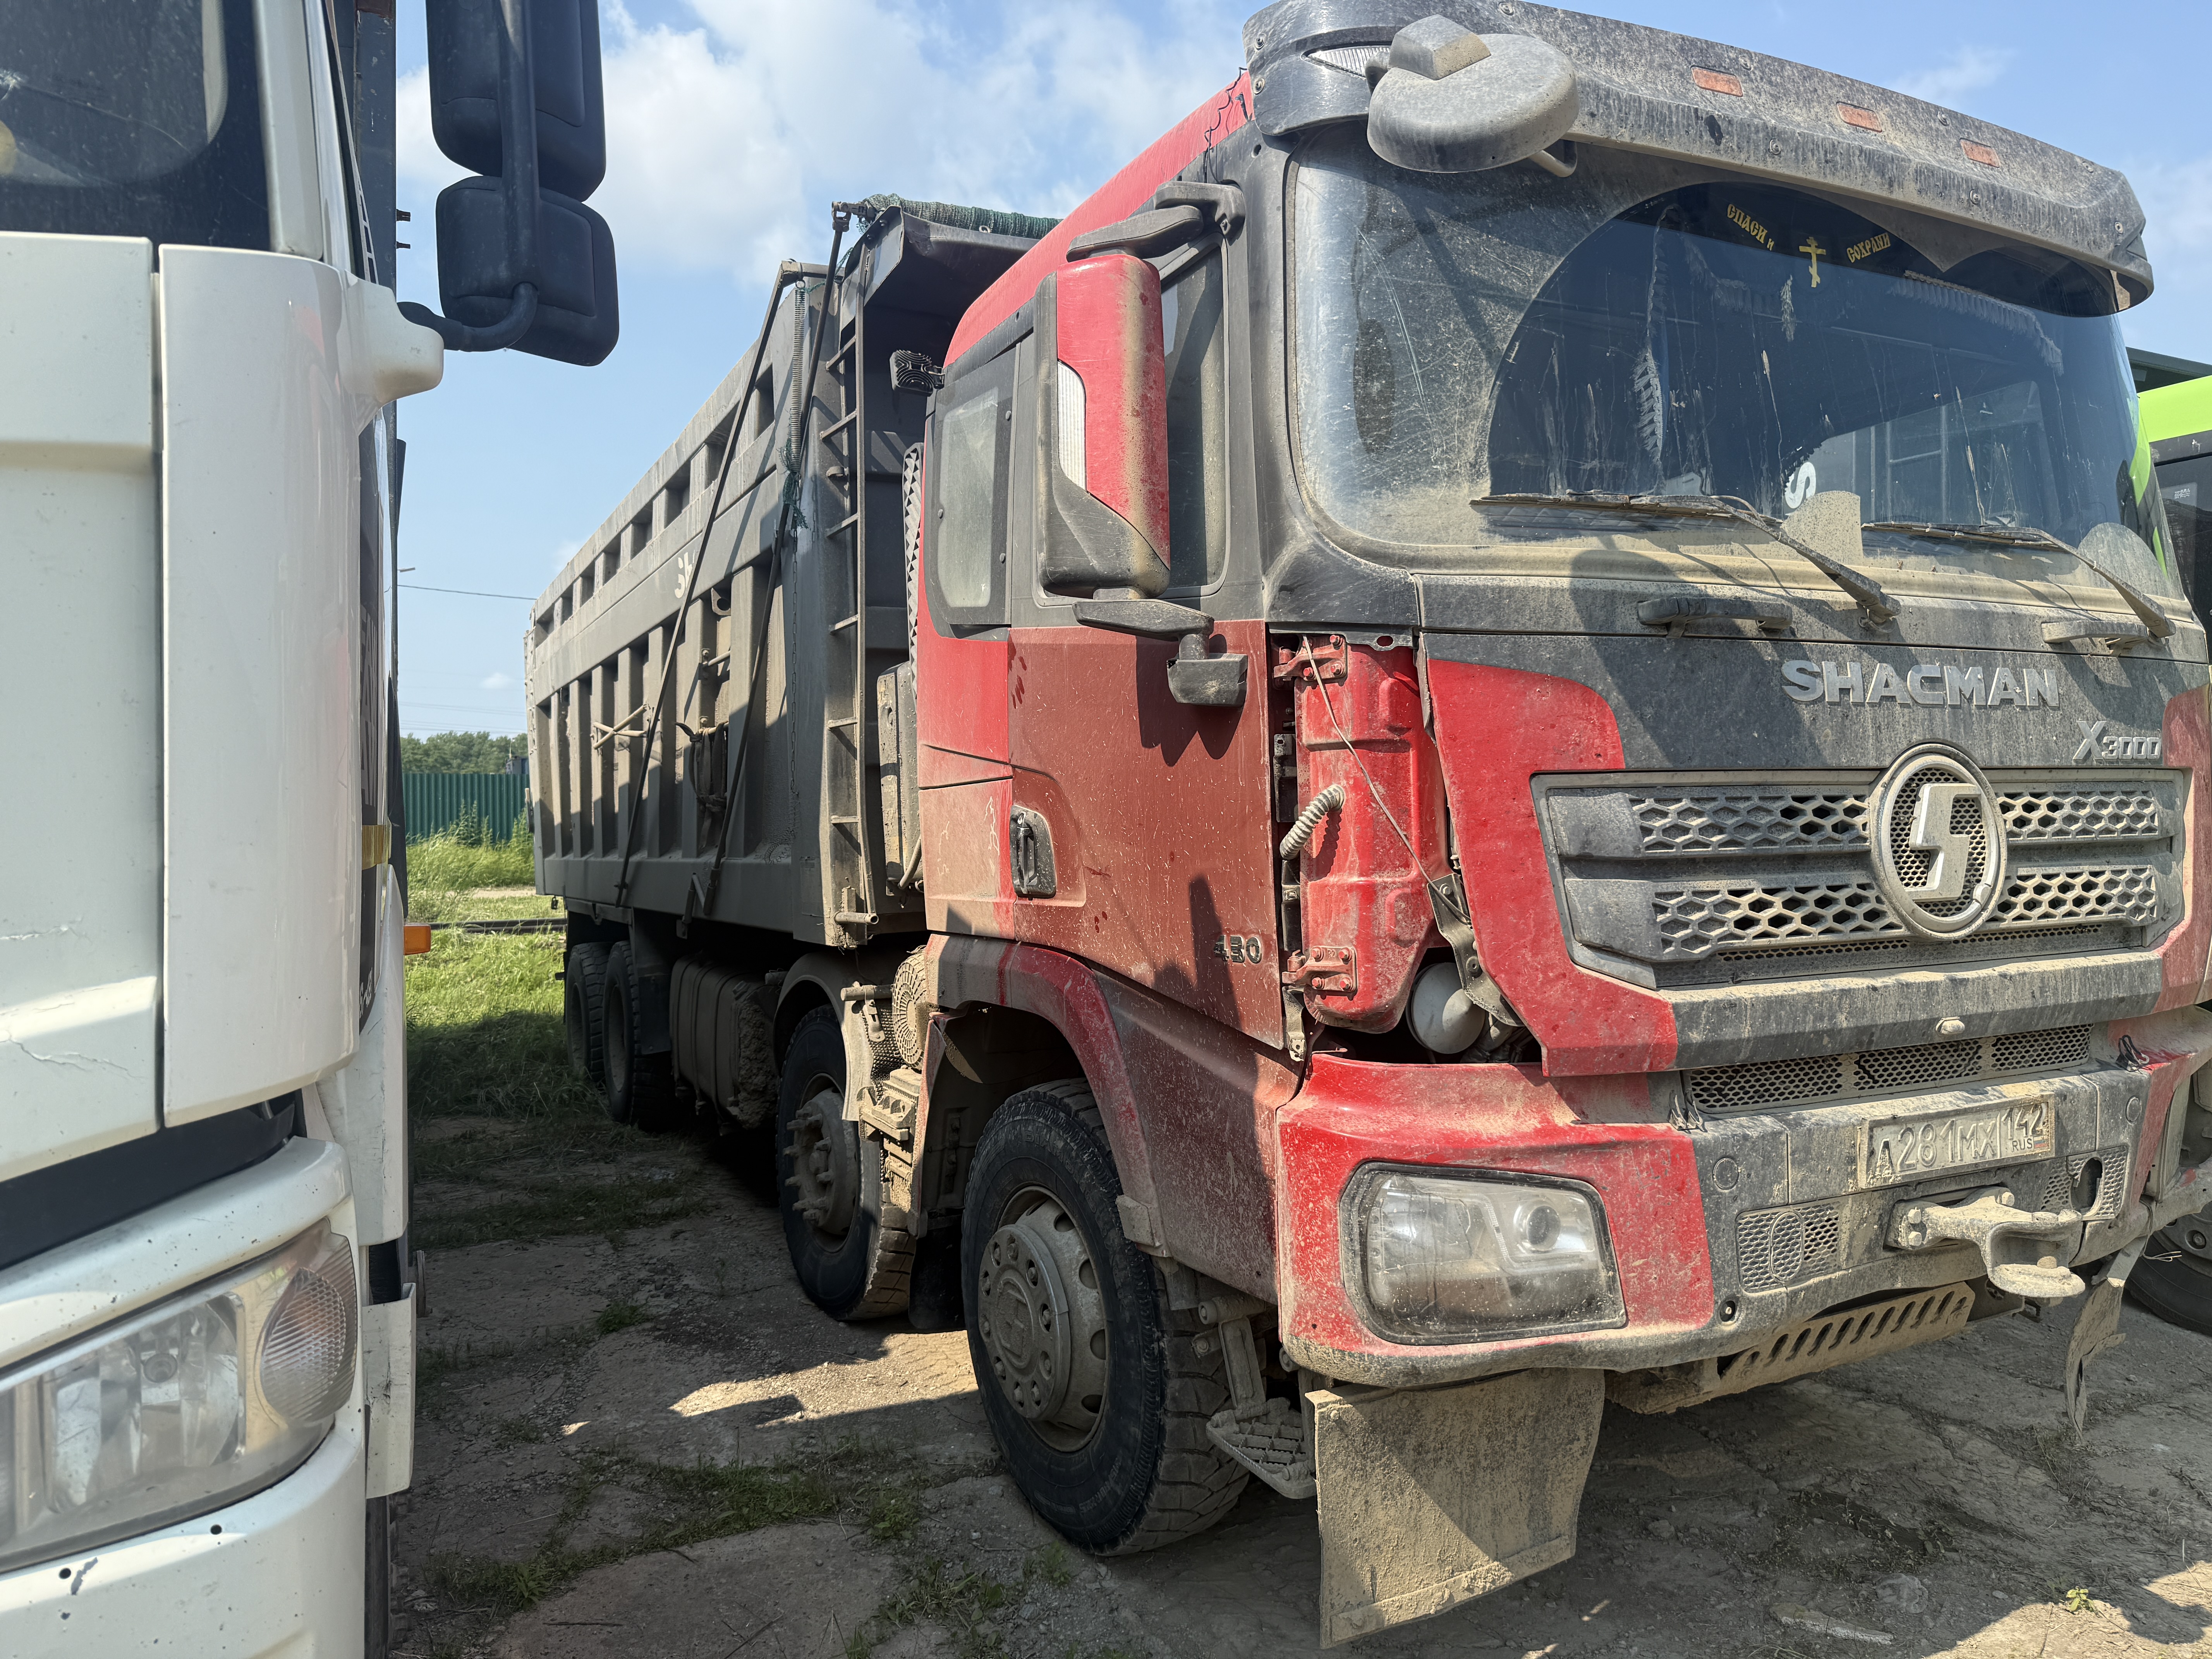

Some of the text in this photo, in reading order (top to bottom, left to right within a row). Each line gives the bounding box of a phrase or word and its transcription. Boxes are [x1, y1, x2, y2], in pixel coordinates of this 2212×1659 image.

[1727, 204, 1767, 244] СПАСИ
[1846, 232, 1891, 263] СОХРАНИ
[1781, 659, 2059, 707] SHACMAN
[2072, 720, 2161, 760] X3000
[2012, 1138, 2033, 1152] RUS
